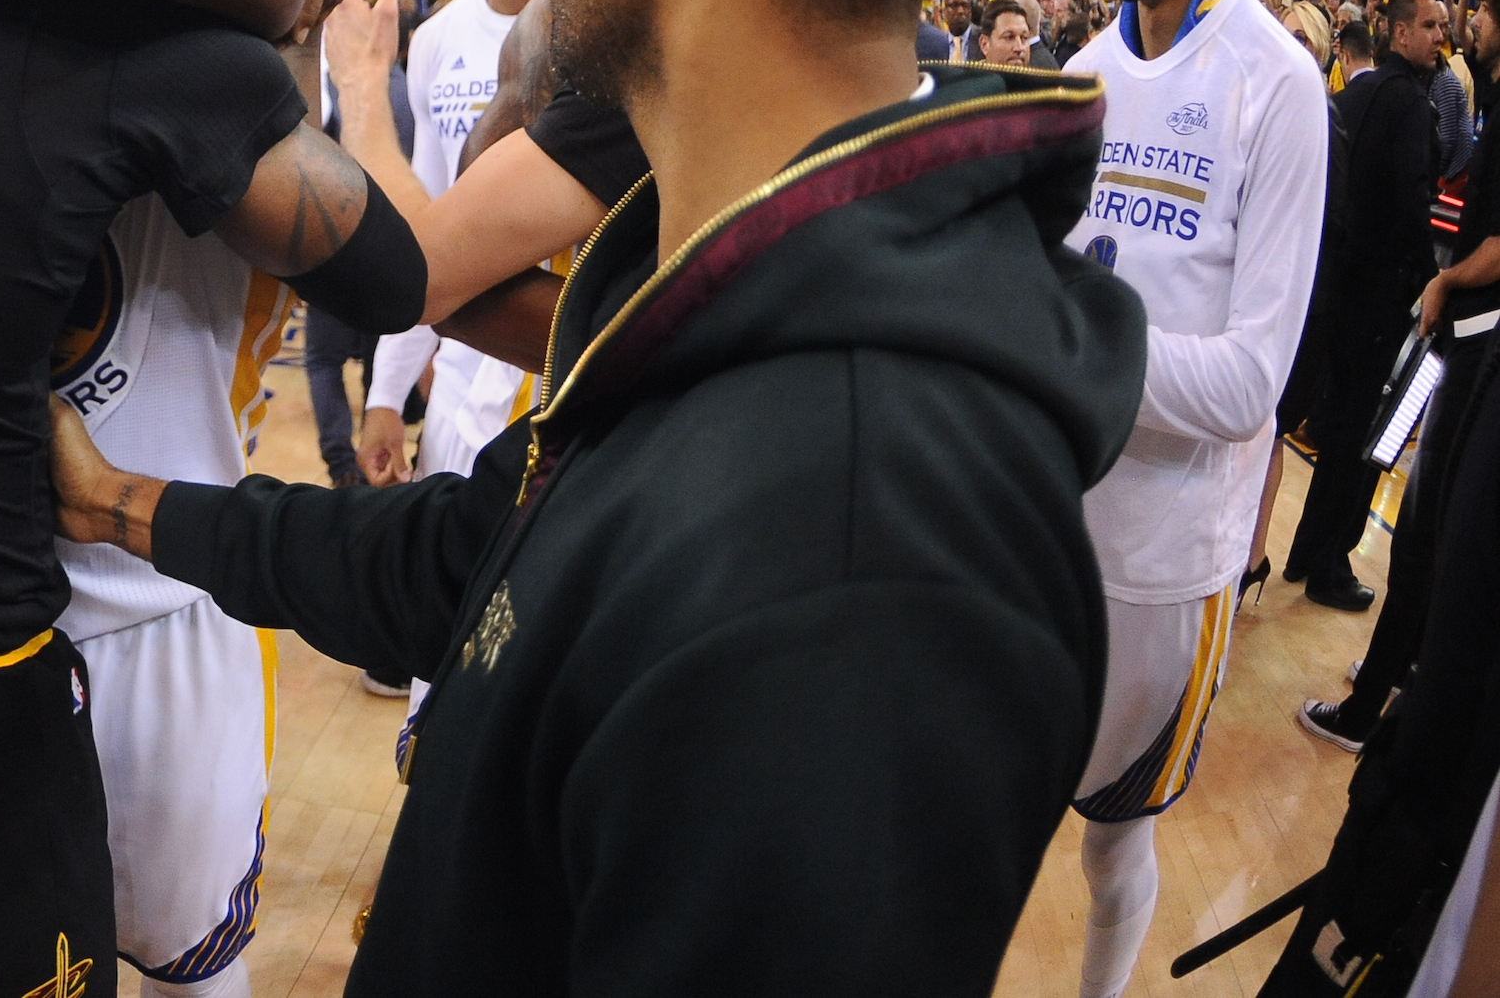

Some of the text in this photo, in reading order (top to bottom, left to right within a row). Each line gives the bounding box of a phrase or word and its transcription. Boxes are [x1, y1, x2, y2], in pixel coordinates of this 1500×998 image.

[432, 80, 498, 100] GOLDE
[1180, 107, 1208, 130] Finals
[1101, 142, 1215, 183] DEN STATE
[1087, 190, 1201, 241] RRIORS
